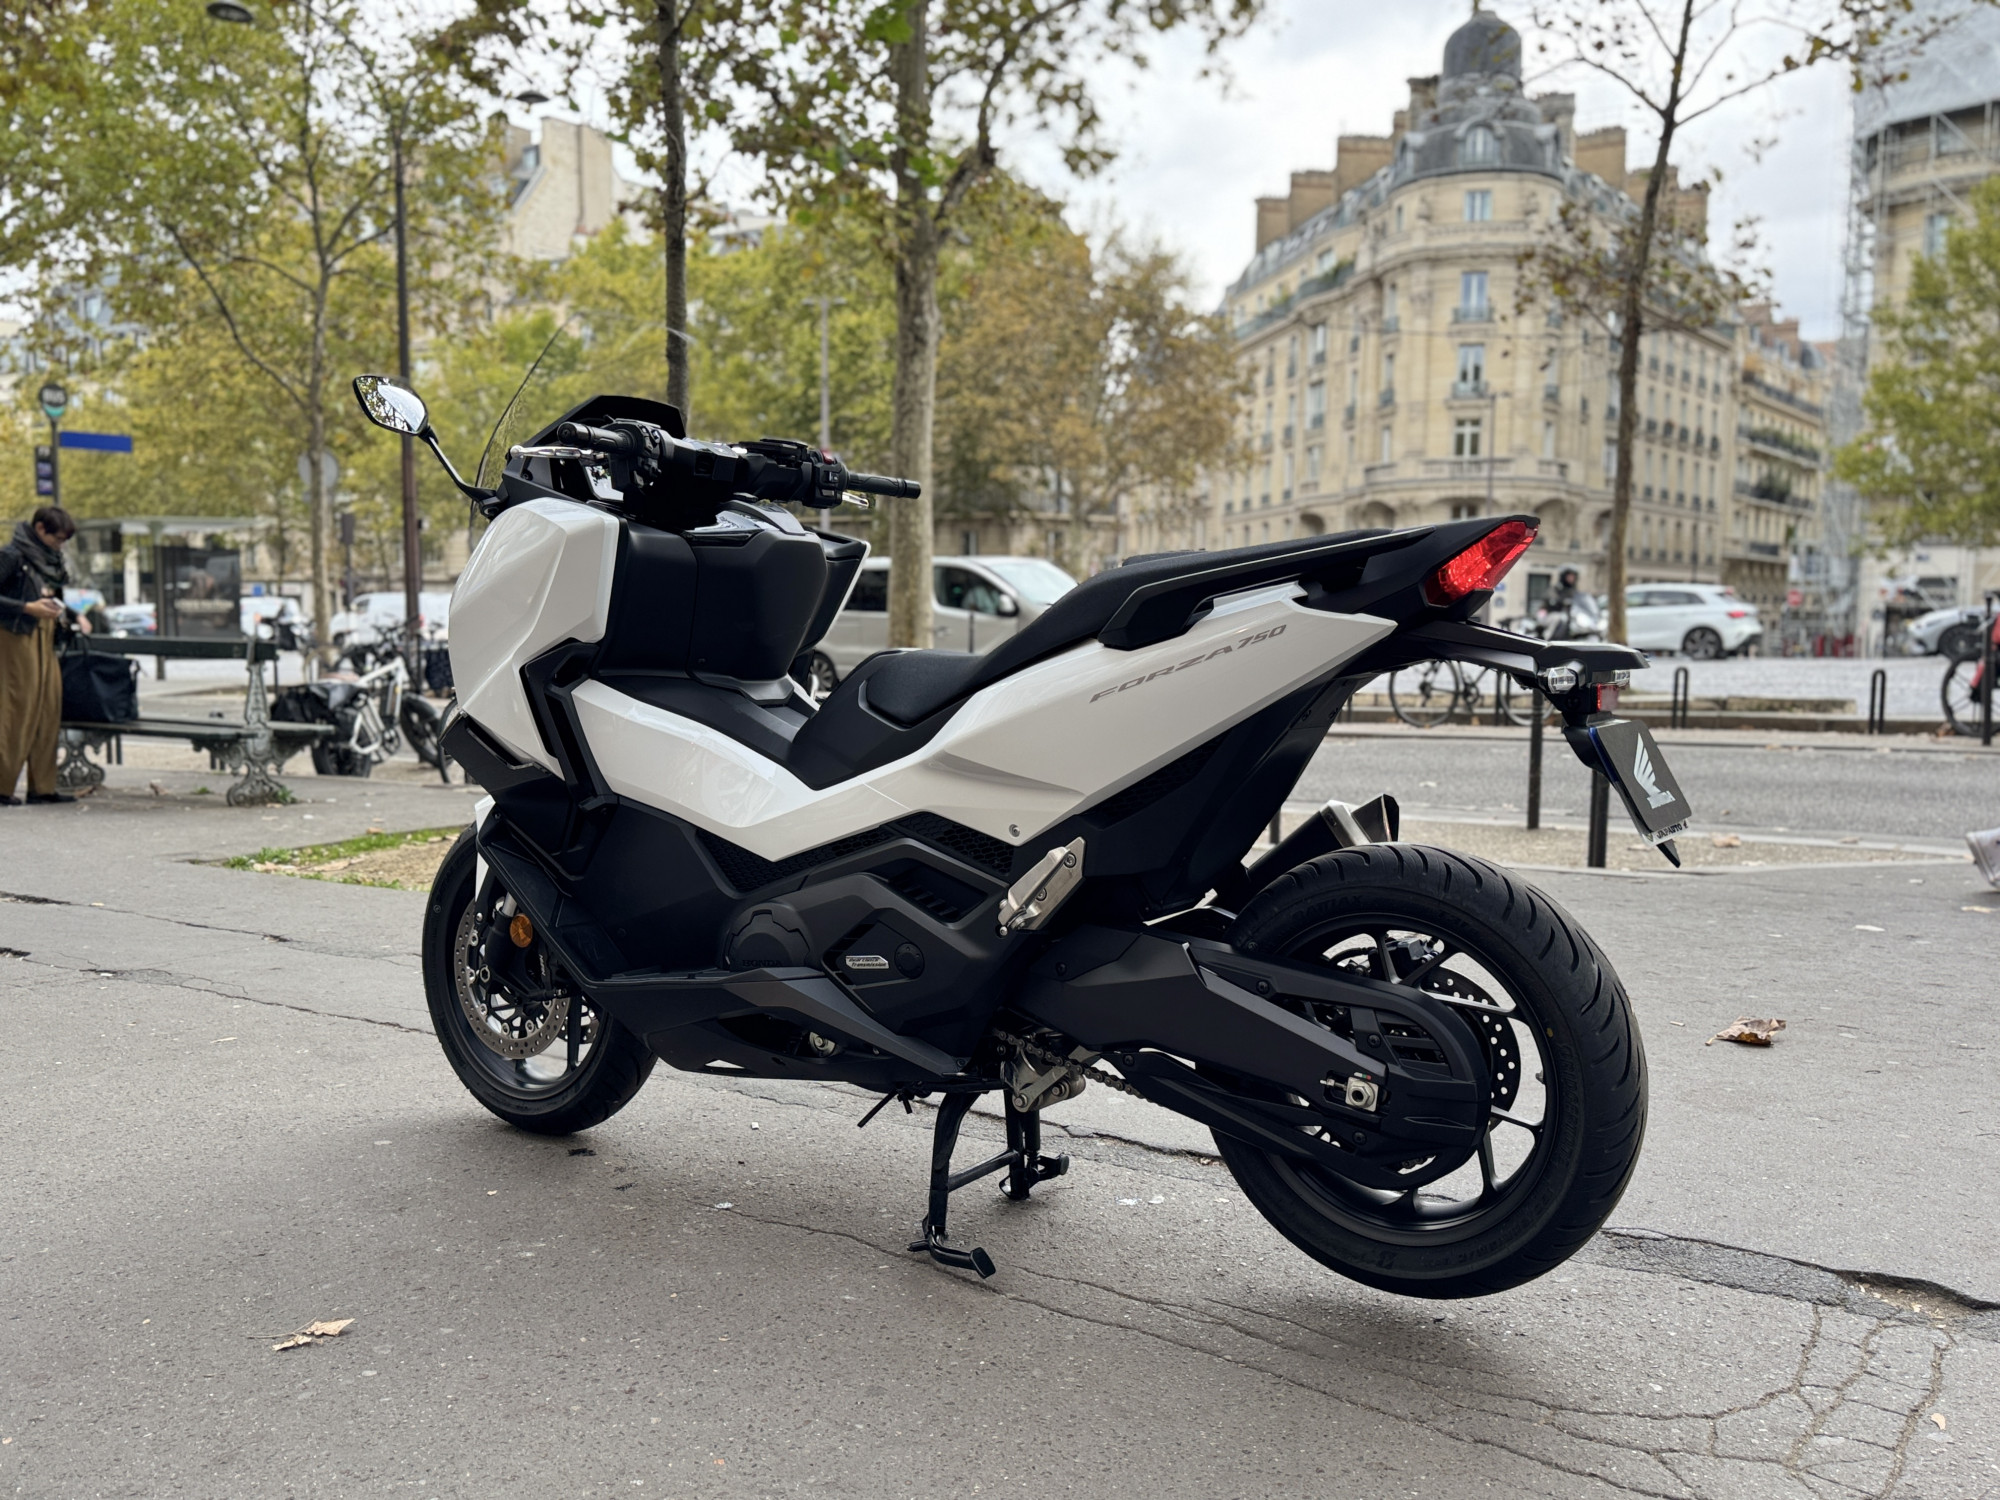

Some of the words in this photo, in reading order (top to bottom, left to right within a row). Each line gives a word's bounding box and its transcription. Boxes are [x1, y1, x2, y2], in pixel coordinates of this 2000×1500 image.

[42, 389, 65, 403] BUS
[1089, 645, 1232, 703] FORZA
[1237, 625, 1287, 650] 750
